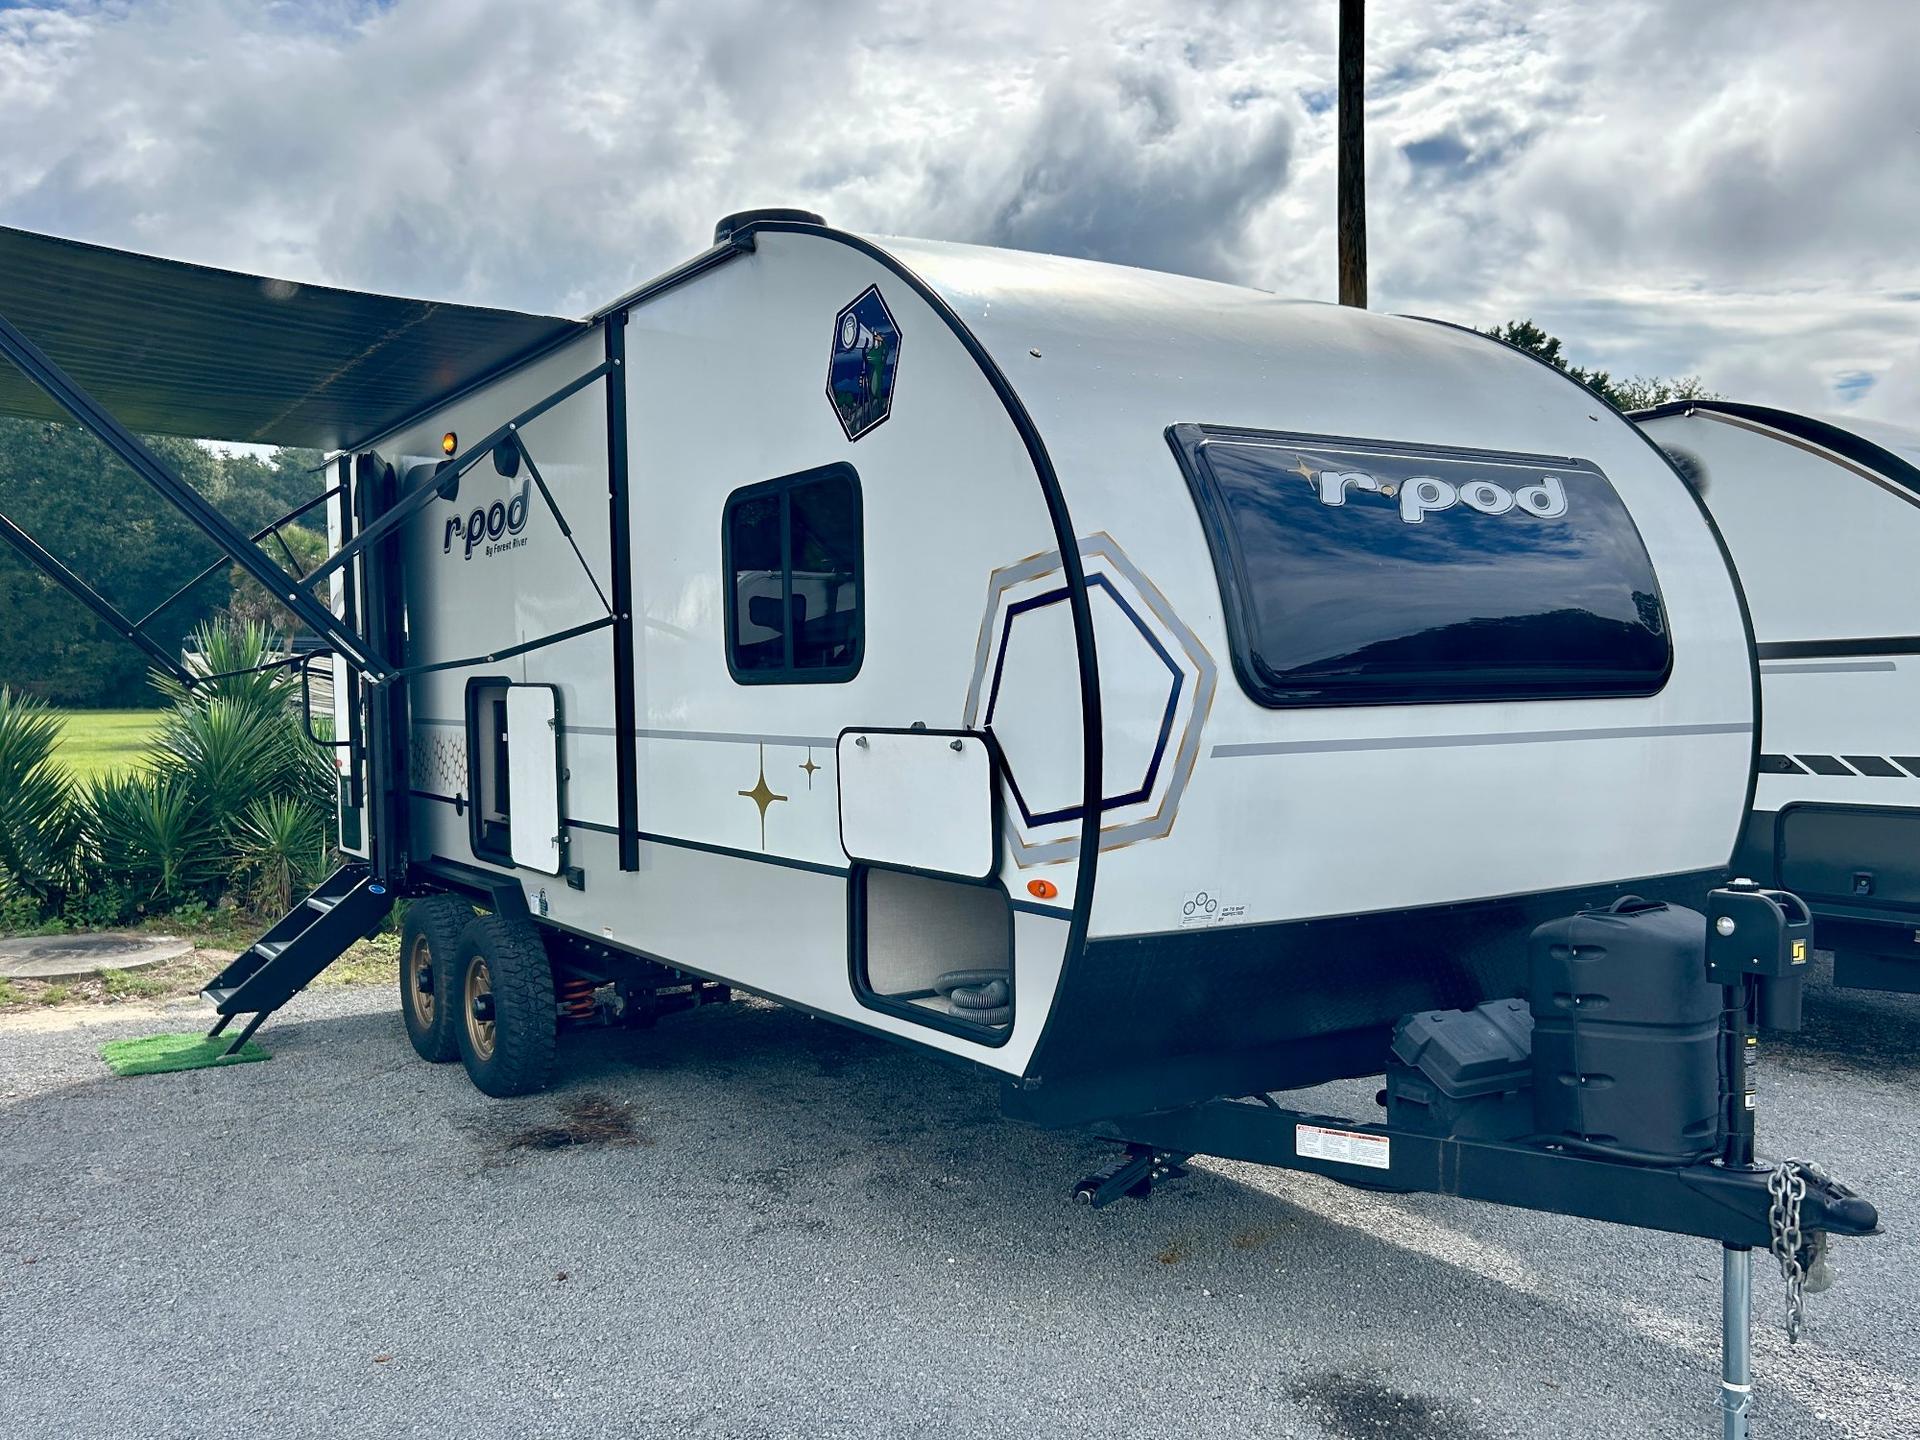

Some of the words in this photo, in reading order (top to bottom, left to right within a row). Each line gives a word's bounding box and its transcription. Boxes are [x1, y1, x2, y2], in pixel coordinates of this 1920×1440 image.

[486, 546, 493, 557] By
[494, 541, 511, 553] Forest
[512, 537, 528, 548] River
